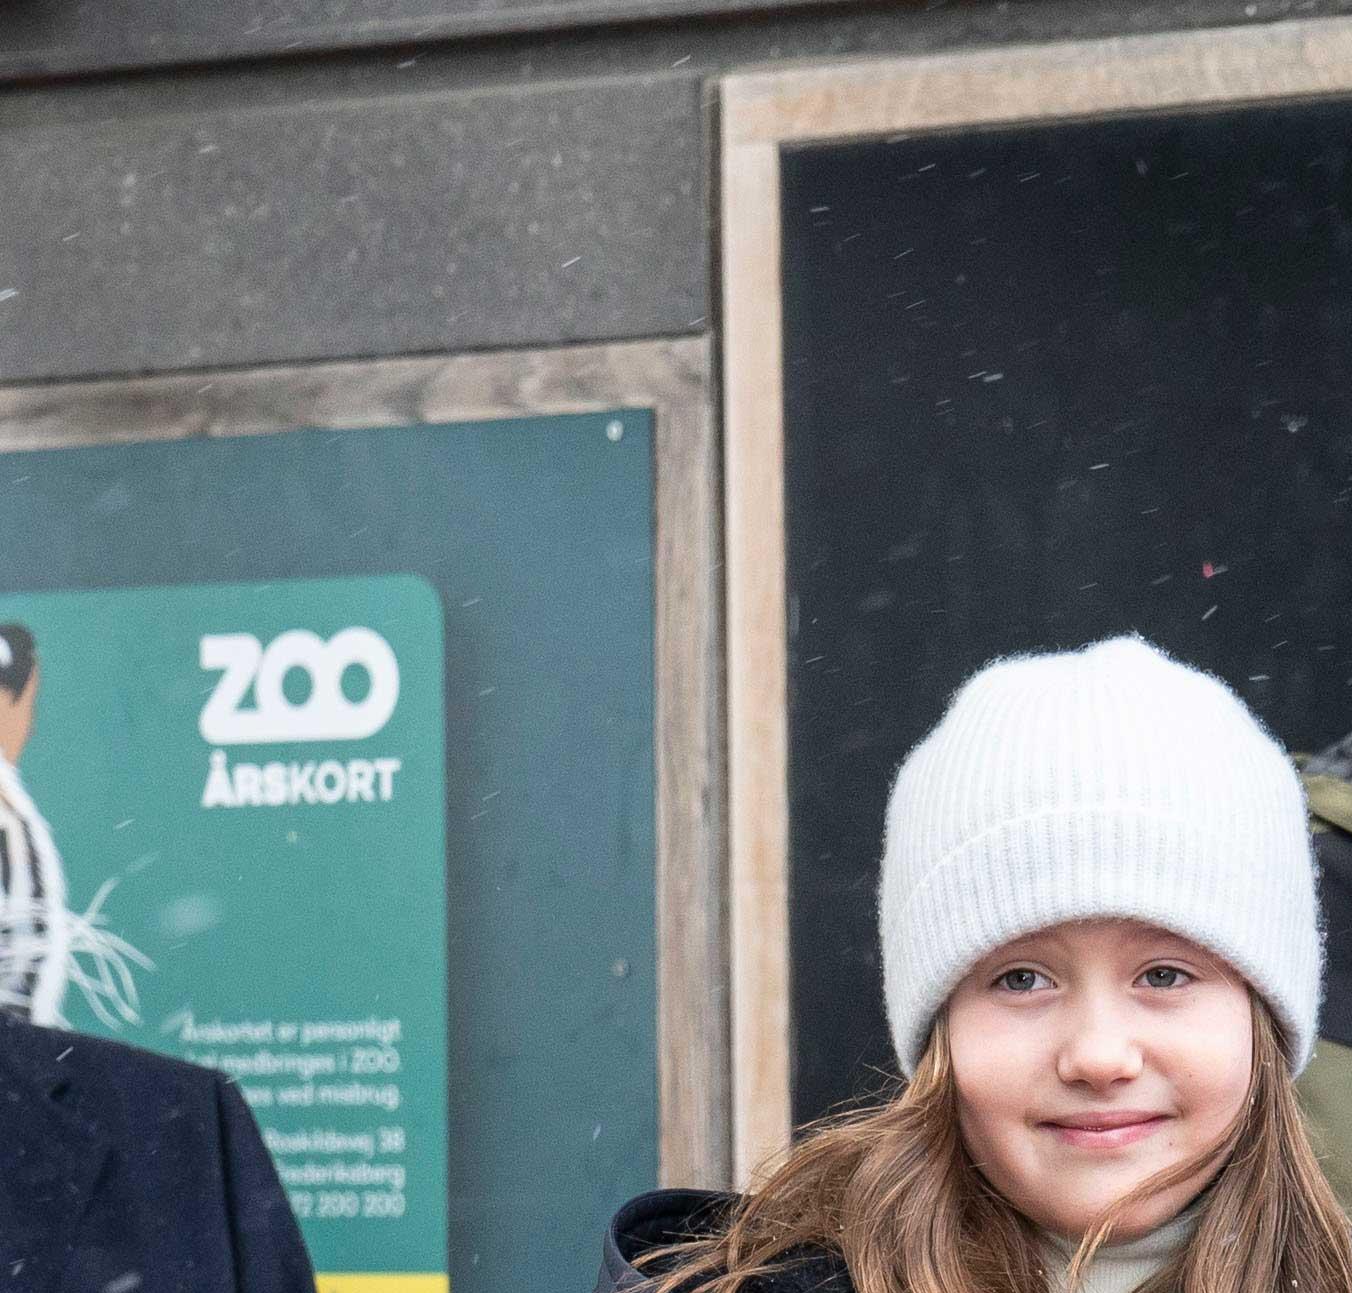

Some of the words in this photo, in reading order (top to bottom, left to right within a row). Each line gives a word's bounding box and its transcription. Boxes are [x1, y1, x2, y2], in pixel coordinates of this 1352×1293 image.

[199, 626, 400, 744] ZOO
[203, 750, 401, 808] ÅRSKORT
[352, 1047, 399, 1073] ZOO
